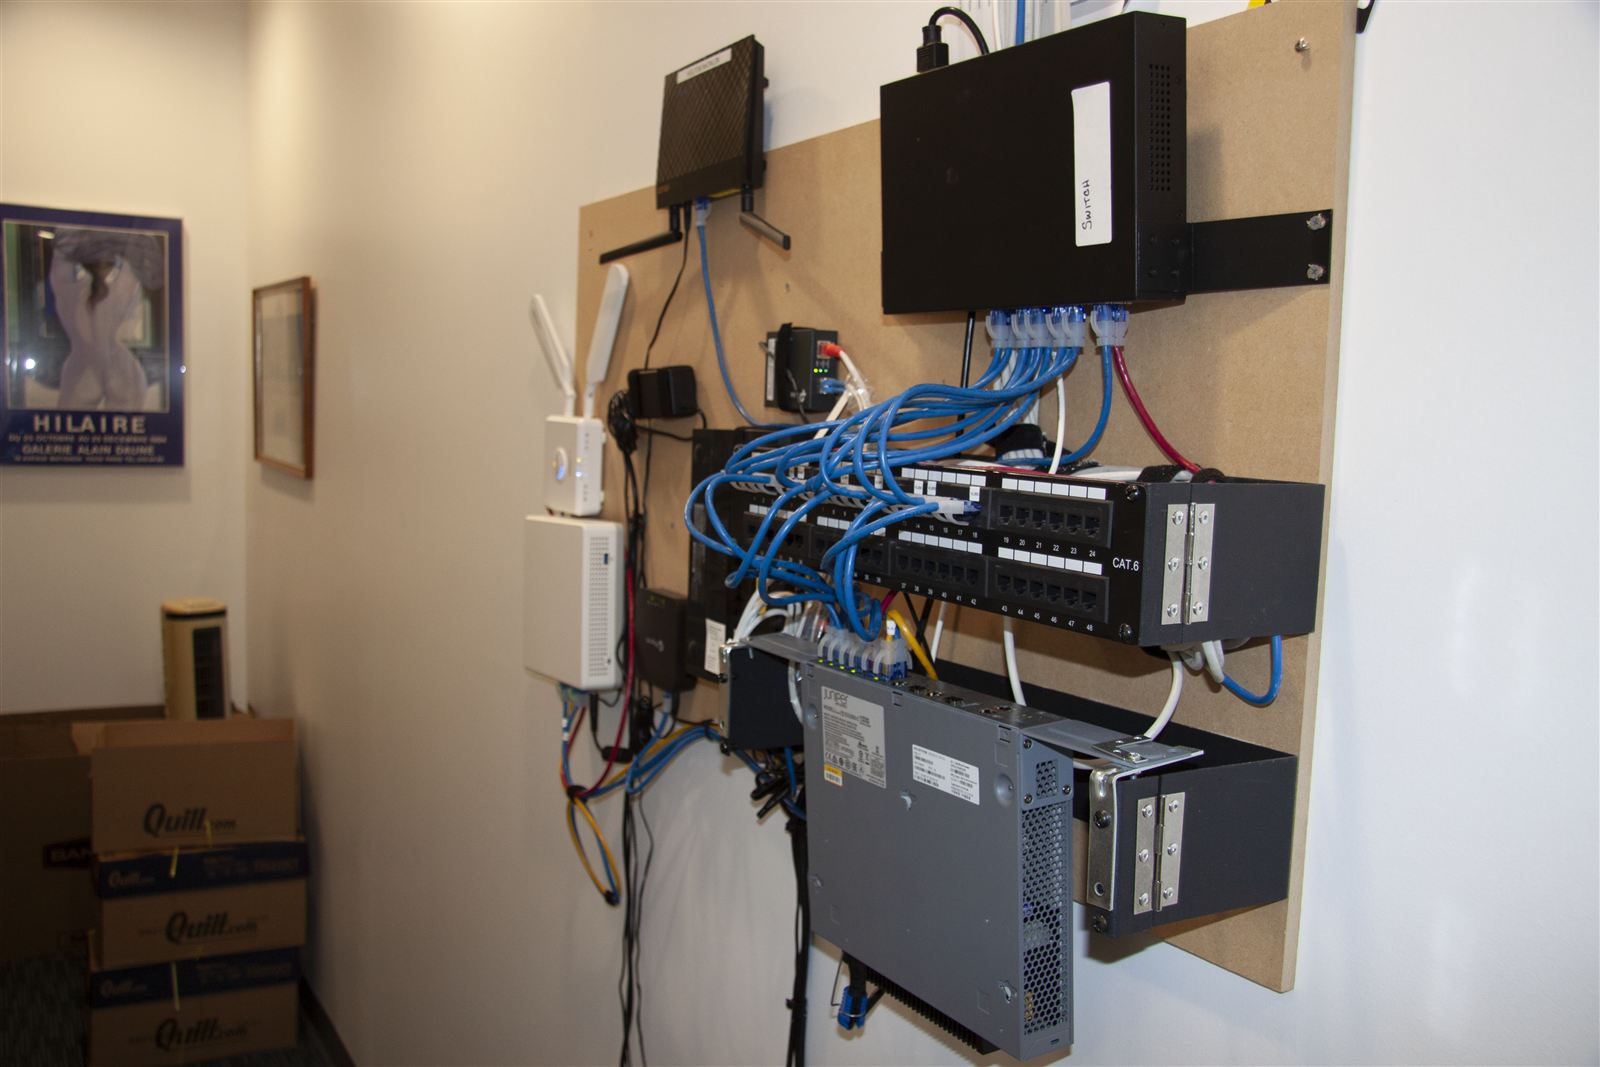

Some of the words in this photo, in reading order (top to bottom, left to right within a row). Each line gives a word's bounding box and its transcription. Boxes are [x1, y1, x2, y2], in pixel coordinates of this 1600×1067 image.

[1082, 179, 1092, 230] SWITCH
[33, 414, 147, 434] HILAIRE
[22, 444, 73, 456] GALERIE
[77, 445, 112, 456] ALAIN
[1003, 536, 1010, 544] 19
[1019, 538, 1026, 546] 20
[1035, 541, 1042, 549] 21
[1053, 544, 1060, 552] 22
[1070, 547, 1077, 555] 23
[1089, 550, 1096, 558] 24
[1112, 557, 1139, 572] CAT.6
[970, 598, 977, 606] 42
[1001, 605, 1008, 613] 43
[1017, 608, 1024, 616] 44
[1034, 611, 1041, 620] 45
[1050, 616, 1058, 624] 46
[1068, 619, 1075, 628] 47
[1086, 623, 1093, 632] 48
